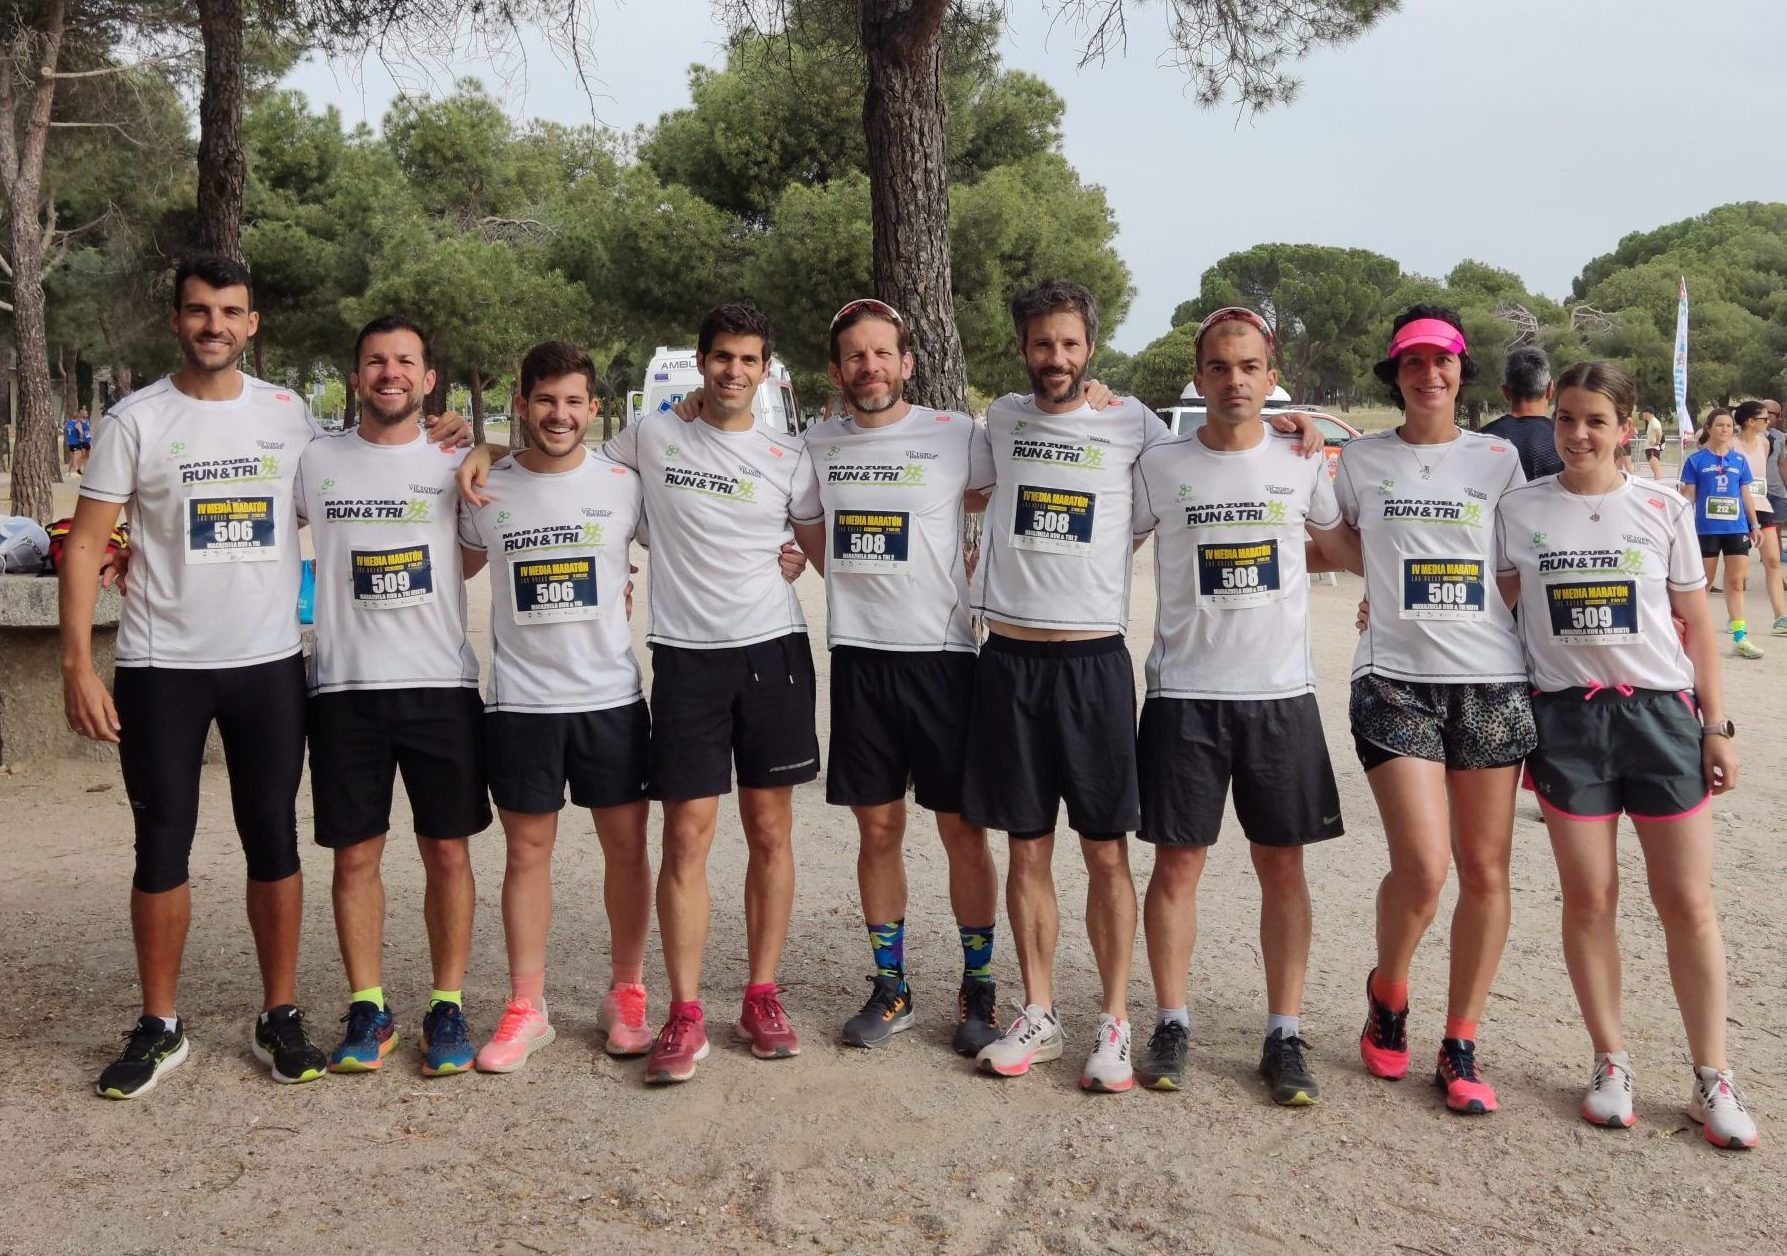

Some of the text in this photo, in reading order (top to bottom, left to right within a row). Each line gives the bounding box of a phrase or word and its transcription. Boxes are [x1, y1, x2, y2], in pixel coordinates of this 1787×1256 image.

[1013, 440, 1085, 452] MARAZUELA
[1012, 446, 1043, 458] RUN
[1055, 450, 1080, 463] TRI
[180, 457, 260, 470] MARAZUELA
[182, 468, 218, 483] RUN
[232, 465, 258, 477] TRI
[665, 466, 739, 483] MARAZUELA
[827, 471, 860, 482] RUN
[873, 471, 899, 481] TRI
[665, 473, 696, 487] RUN
[709, 480, 734, 494] TRI
[1030, 491, 1052, 504] MEDIA
[1384, 499, 1464, 507] MARAZUELA
[207, 502, 231, 514] MEDIA
[326, 507, 360, 519] RUN
[375, 507, 403, 518] TRI
[1185, 502, 1267, 512] MARAZUELA
[1383, 506, 1420, 517] RUN
[1434, 507, 1460, 519] TRI
[846, 515, 867, 526] MEDIA
[1032, 510, 1070, 533] 508
[1187, 511, 1221, 525] RUN
[1236, 509, 1263, 521] TRI
[214, 521, 253, 542] 506
[502, 524, 585, 539] MARAZUELA
[504, 536, 538, 551] RUN
[552, 532, 579, 544] TRI
[850, 533, 886, 554] 508
[363, 555, 387, 566] MEDIA
[1214, 548, 1238, 560] MEDIA
[1538, 550, 1623, 559] MARAZUELA
[529, 565, 552, 576] MEDIA
[1421, 564, 1446, 575] MEDIA
[1539, 557, 1574, 572] RUN
[1590, 556, 1618, 568] TRI
[371, 571, 410, 593] 509
[1221, 566, 1259, 588] 508
[536, 582, 574, 604] 506
[1428, 582, 1467, 604] 509
[1562, 588, 1588, 599] MEDIA
[1570, 606, 1612, 629] 509
